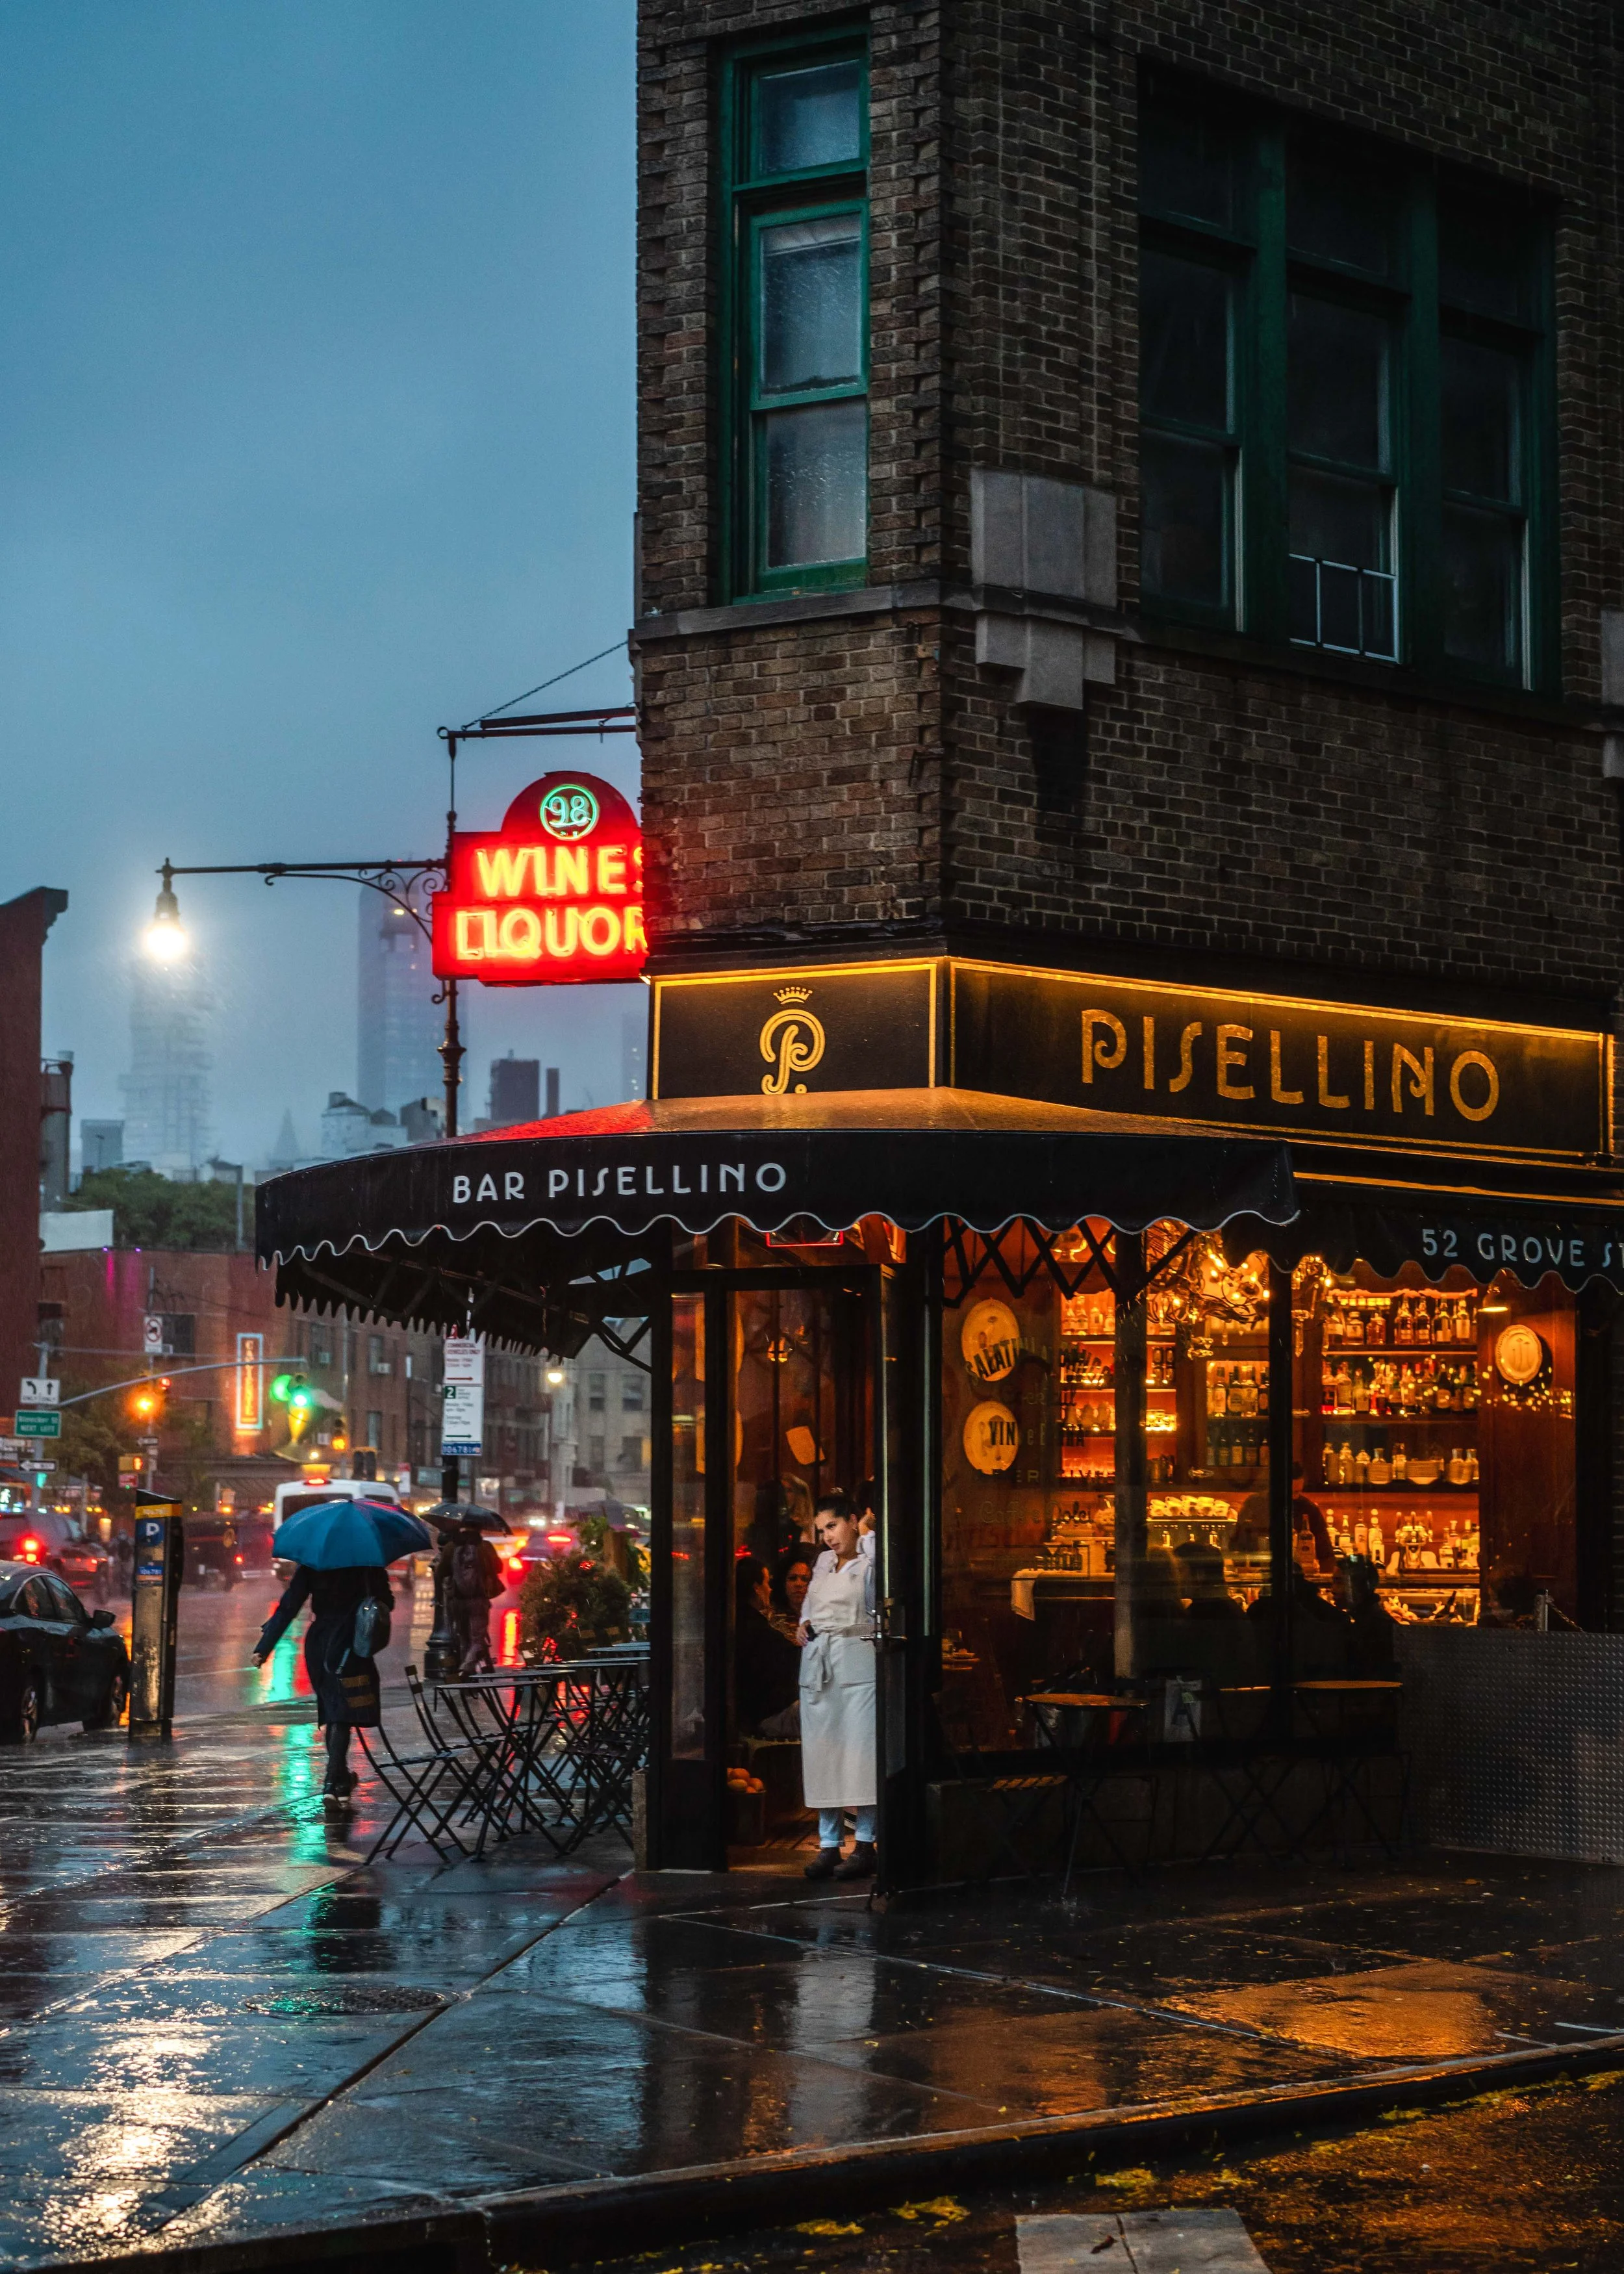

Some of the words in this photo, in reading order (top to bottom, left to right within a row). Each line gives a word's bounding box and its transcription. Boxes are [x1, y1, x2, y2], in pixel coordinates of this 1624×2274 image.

[549, 795, 588, 826] 98
[1081, 1008, 1500, 1122] PISELLINO
[453, 1172, 525, 1203] BAR
[549, 1163, 787, 1198] PISELLINO
[1422, 1229, 1458, 1258] 52
[1477, 1233, 1585, 1267] GROVE
[447, 1386, 454, 1398] 2
